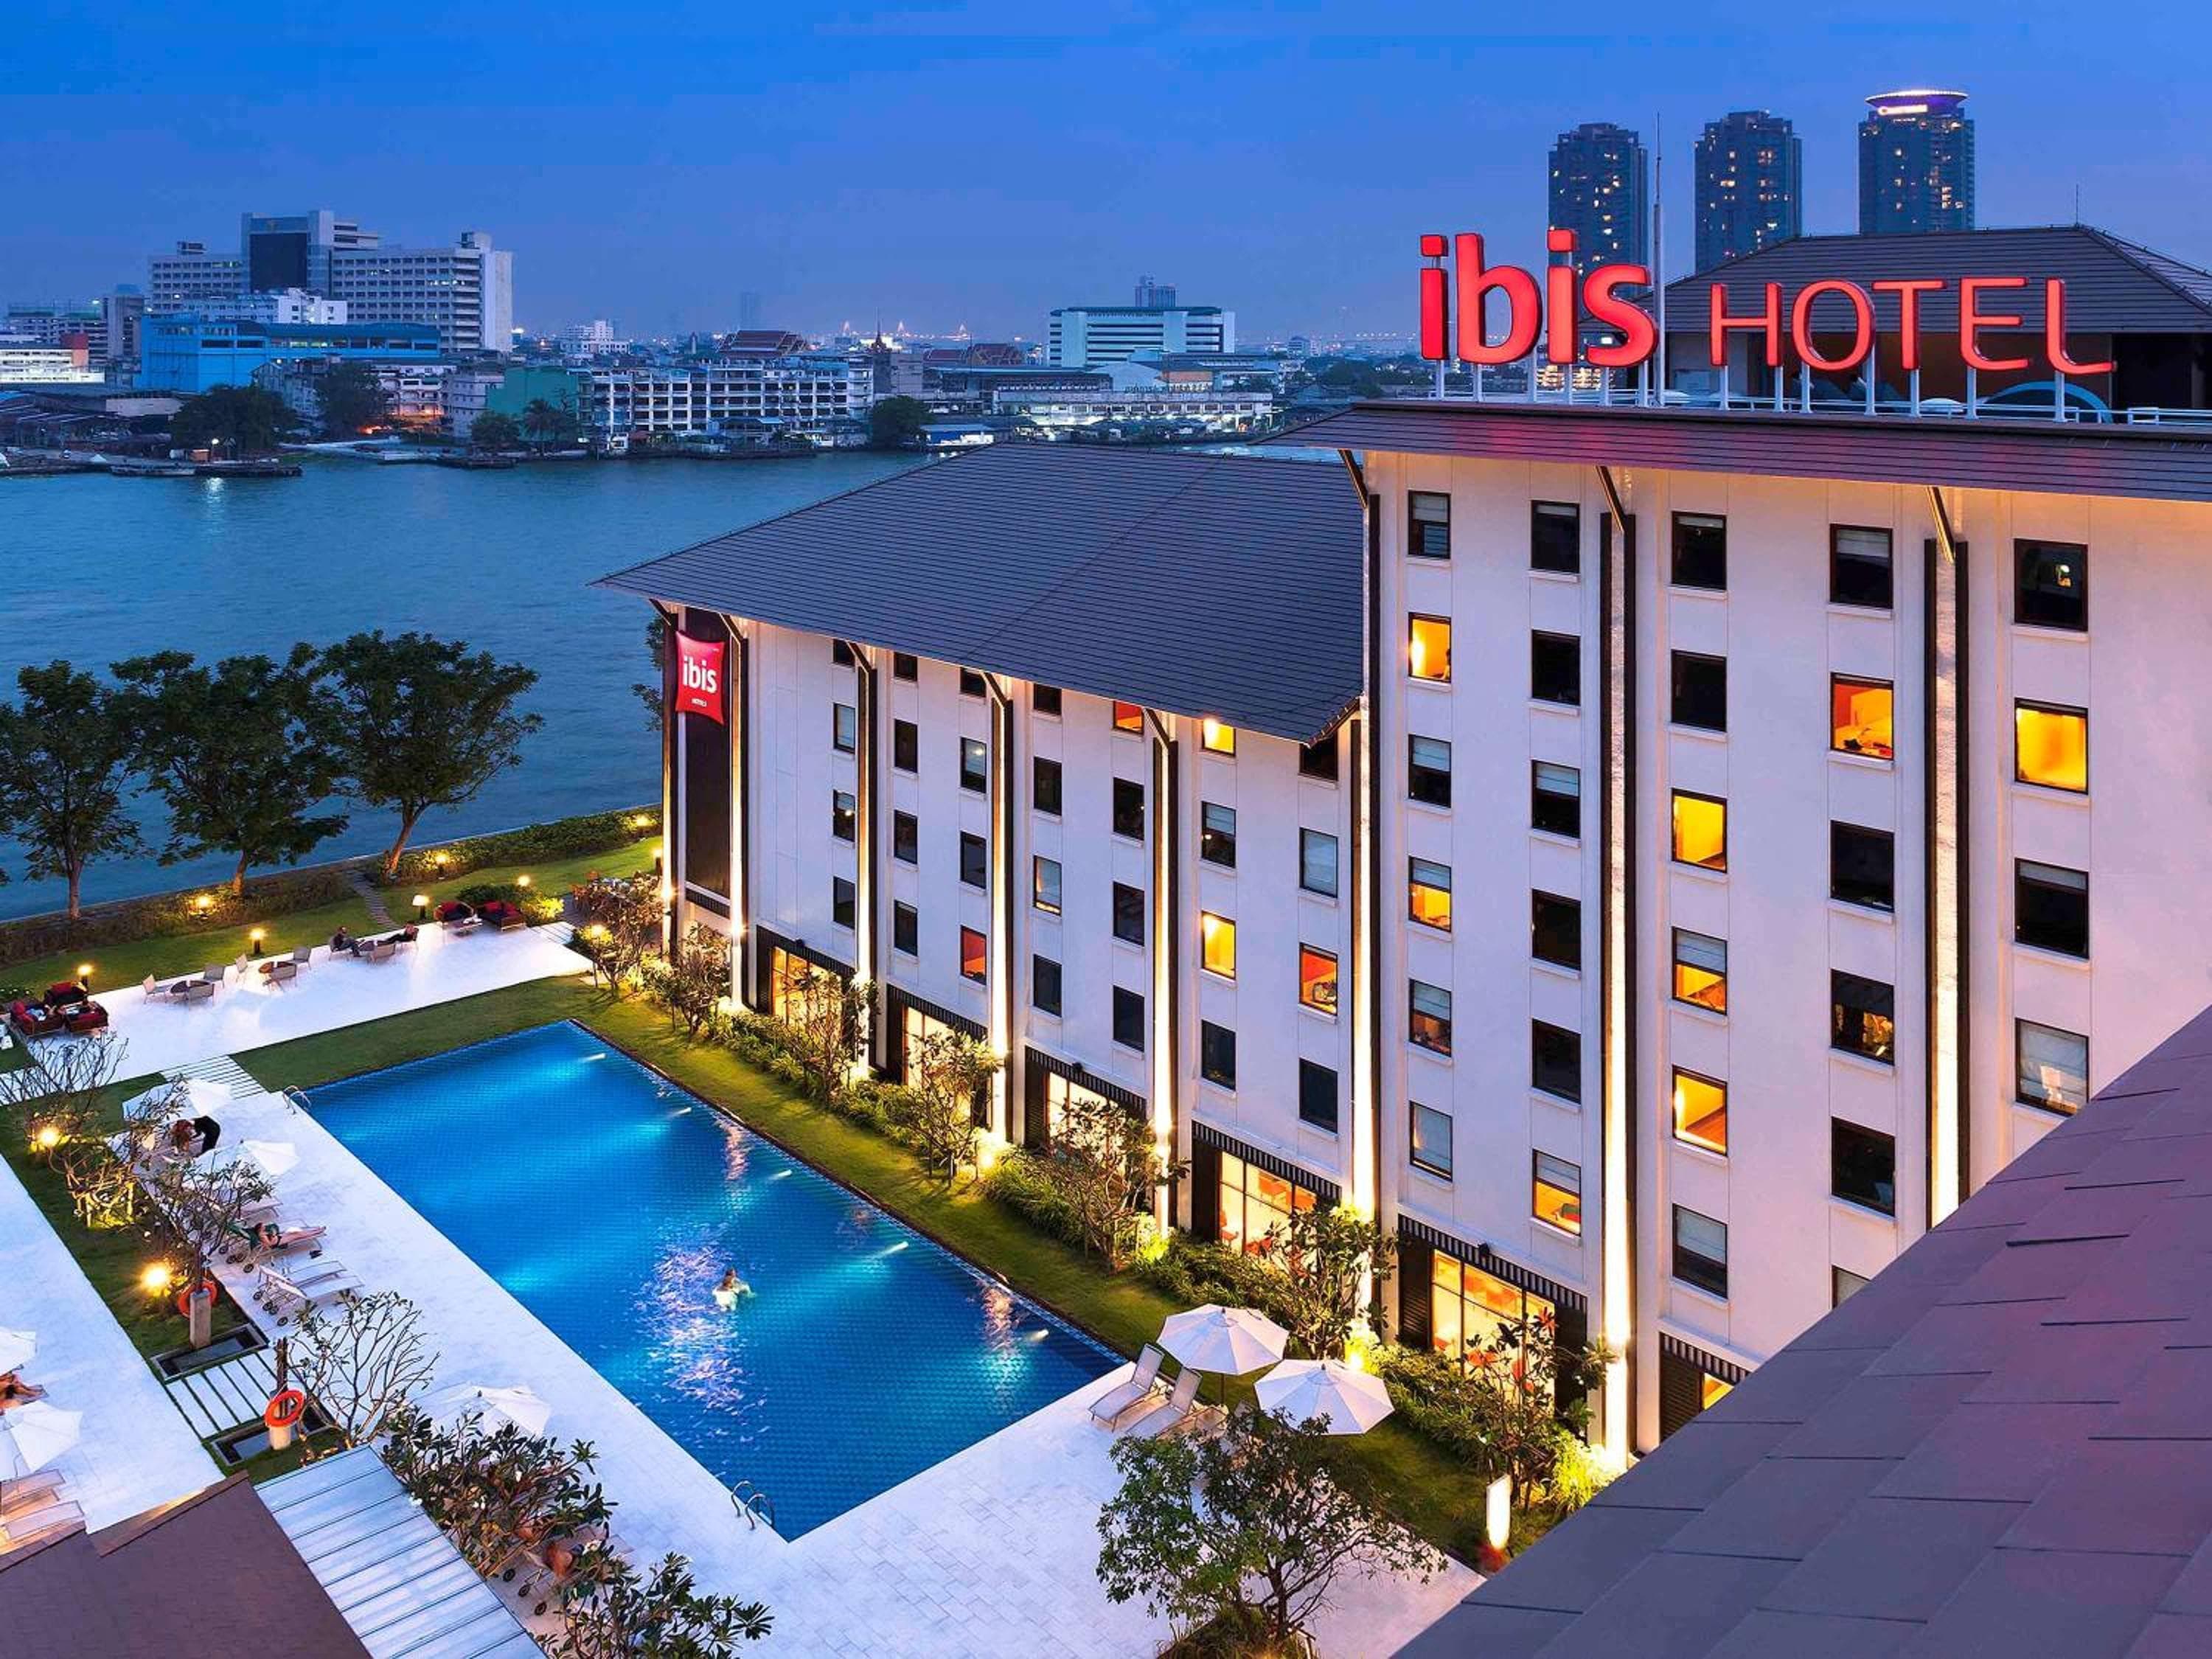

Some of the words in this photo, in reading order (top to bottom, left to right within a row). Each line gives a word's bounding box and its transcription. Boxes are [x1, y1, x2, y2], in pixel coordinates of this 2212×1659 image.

[1419, 228, 1659, 369] ibis
[1710, 276, 2117, 375] HOTEL
[683, 655, 717, 694] ibis
